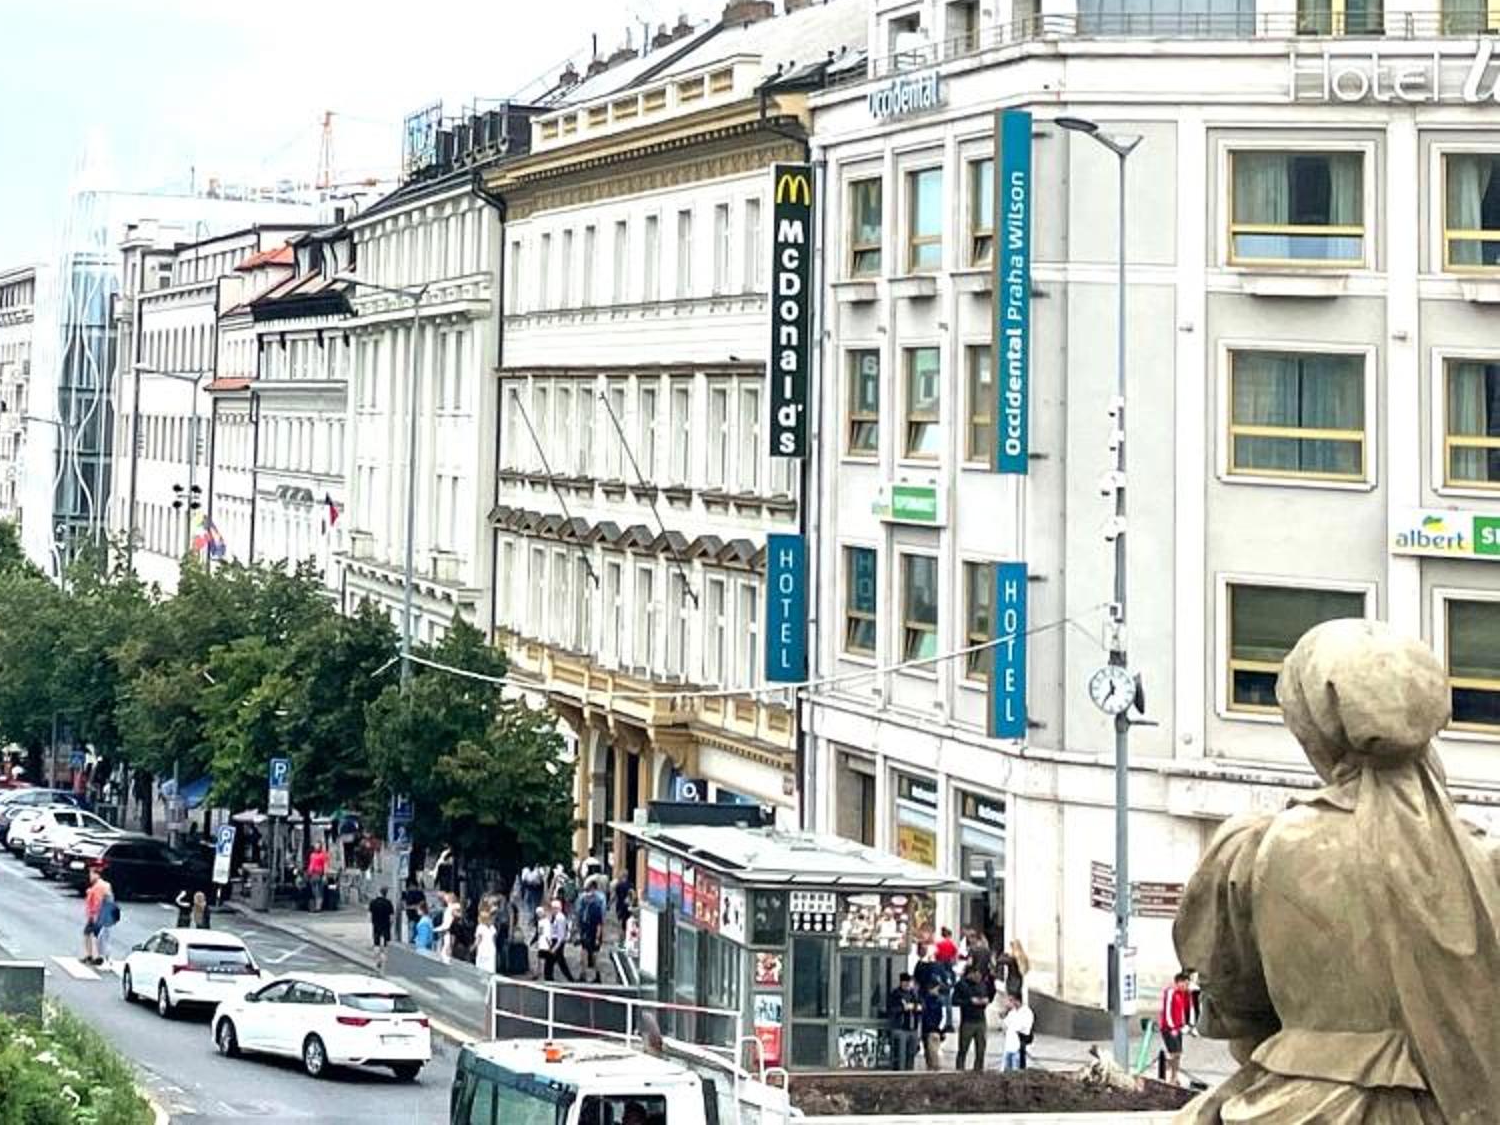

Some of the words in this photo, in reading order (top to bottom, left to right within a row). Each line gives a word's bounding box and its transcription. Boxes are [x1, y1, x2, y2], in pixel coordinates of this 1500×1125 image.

[1289, 49, 1440, 103] Hotel
[1008, 171, 1025, 250] Wilson
[1007, 256, 1023, 321] Praha
[1004, 328, 1023, 456] Occidental
[1395, 529, 1466, 550] albert
[779, 548, 793, 668] HOTEL
[1004, 580, 1018, 722] HOTEL
